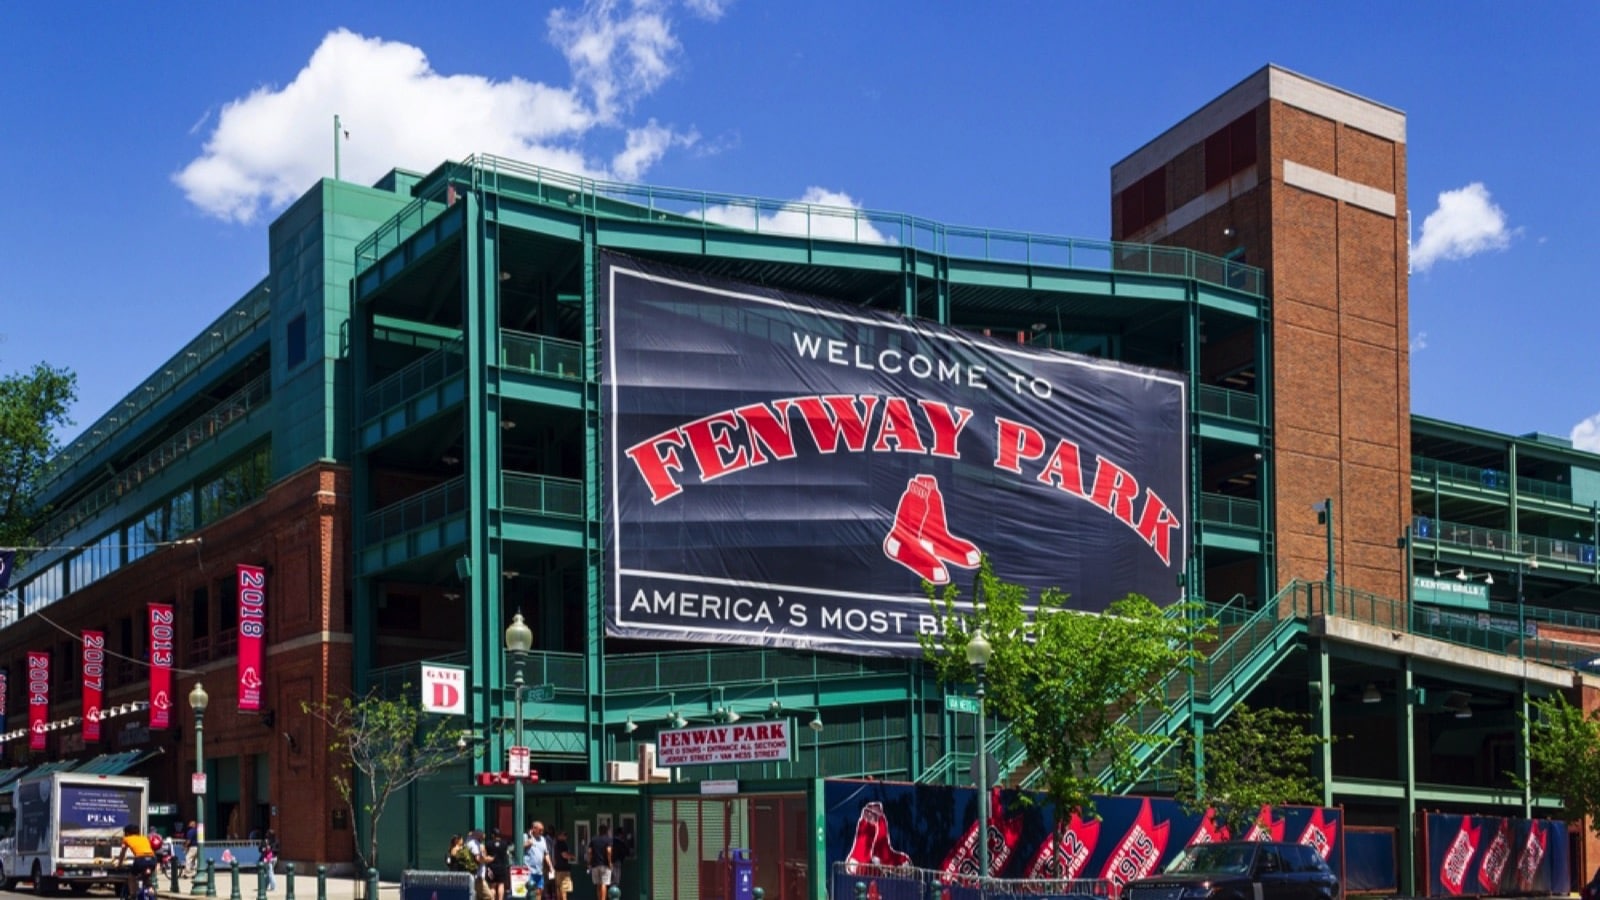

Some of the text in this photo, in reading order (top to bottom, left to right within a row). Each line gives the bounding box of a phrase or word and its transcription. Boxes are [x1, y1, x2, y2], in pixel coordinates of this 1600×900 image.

[793, 332, 1054, 400] WELCOME TO
[624, 394, 1182, 568] FENWAY PARK
[241, 570, 264, 638] 2018
[630, 588, 808, 628] AMERICA'S
[821, 608, 908, 636] MOST
[152, 609, 173, 667] 2013
[29, 656, 48, 706] 2004
[84, 634, 104, 692] 2007
[426, 670, 460, 680] GATE
[432, 682, 459, 709] D
[660, 723, 784, 747] FENWAY PARK
[665, 755, 688, 763] JERSEY
[720, 752, 732, 760] VAN
[754, 750, 780, 758] STREET
[707, 744, 738, 753] ENTRANCE
[741, 742, 752, 750] ALL
[754, 740, 787, 749] SECTIONS
[87, 813, 116, 823] PEAK
[1111, 833, 1155, 888] 1915
